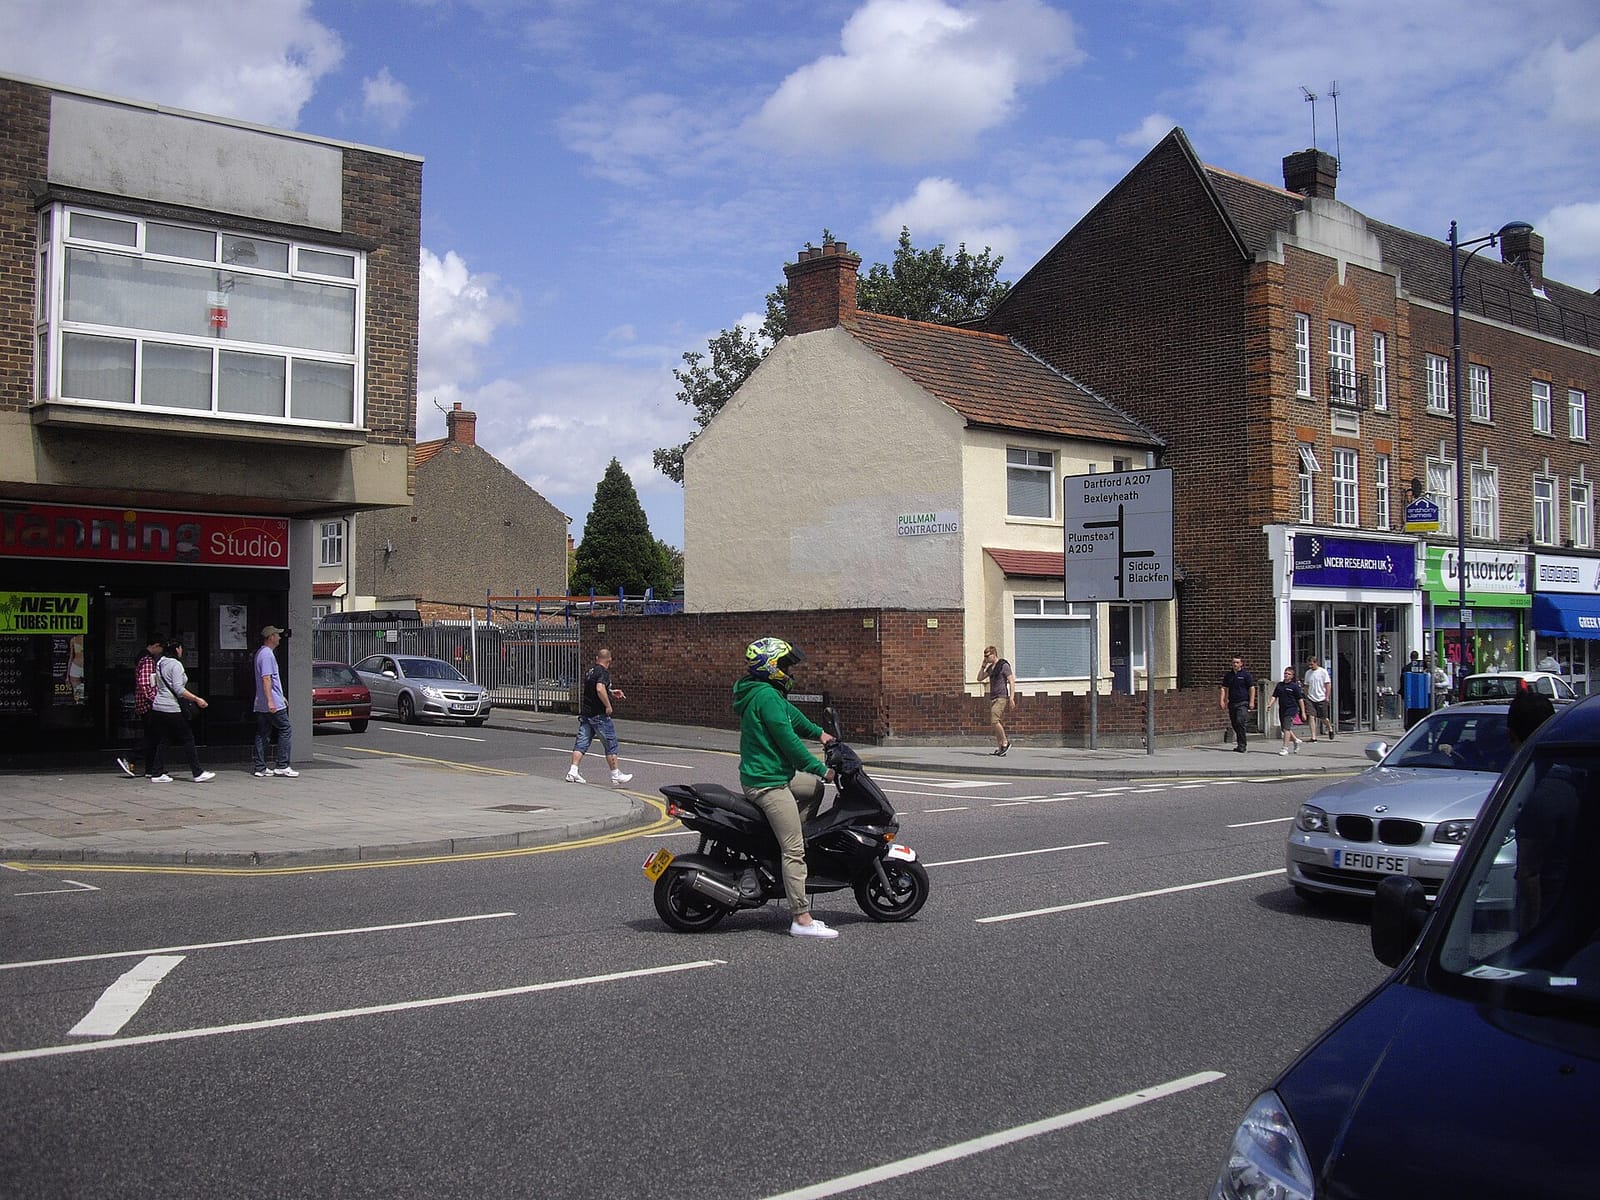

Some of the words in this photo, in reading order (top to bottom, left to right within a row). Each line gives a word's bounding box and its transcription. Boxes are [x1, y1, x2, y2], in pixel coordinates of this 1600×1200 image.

[1083, 477, 1122, 489] Dartford
[1124, 475, 1151, 486] A207
[1083, 491, 1139, 503] Bexleyheath
[898, 513, 936, 524] PULLMAN
[0, 504, 202, 562] Tanning
[210, 532, 282, 558] Studio
[898, 523, 958, 535] CONTRACTING
[1068, 531, 1114, 543] Plumstead
[1068, 544, 1094, 554] A209
[1128, 562, 1160, 572] Sidcup
[1344, 558, 1377, 570] RESEARCH
[1377, 560, 1387, 570] UK
[1448, 553, 1514, 588] Lquorice
[1128, 573, 1169, 583] Blackfen
[20, 597, 80, 613] NEW
[14, 614, 48, 629] TUBES
[49, 615, 83, 630] FITTED
[1344, 852, 1373, 868] EF10
[1376, 856, 1404, 872] FSE
